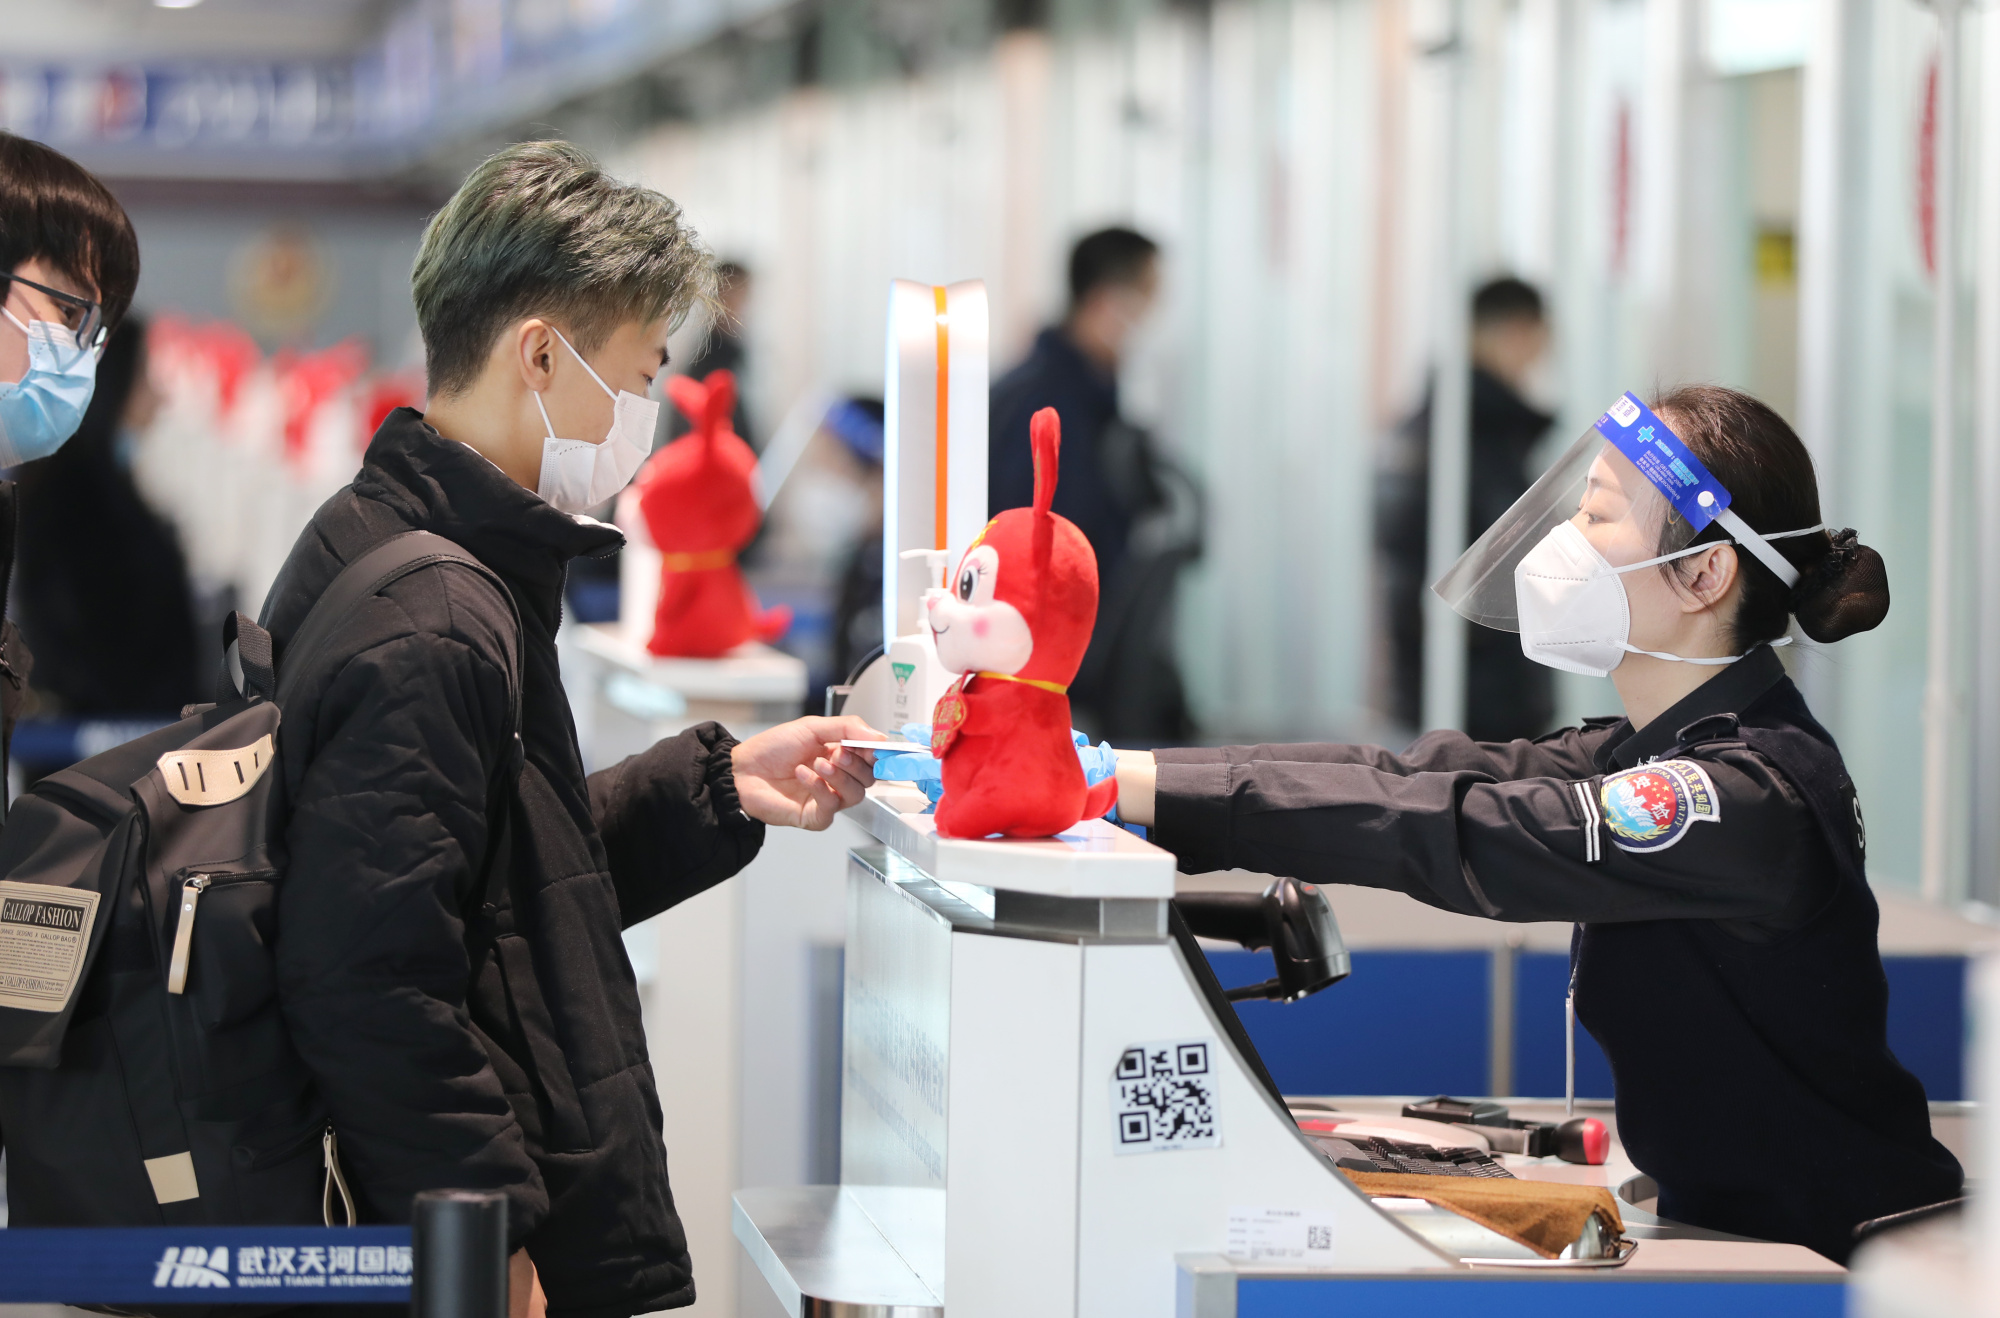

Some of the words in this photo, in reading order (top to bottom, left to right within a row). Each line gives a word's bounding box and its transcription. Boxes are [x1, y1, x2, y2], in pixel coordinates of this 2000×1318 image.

[1645, 768, 1671, 780] CHINA
[1672, 781, 1686, 828] SECURITY
[3, 901, 35, 922] GALLOP
[34, 905, 82, 929] FASHION
[41, 932, 60, 941] GALLOP
[237, 1245, 413, 1275] 武汉天河国际
[236, 1275, 282, 1288] WUHAN
[284, 1275, 327, 1288] TIANHE
